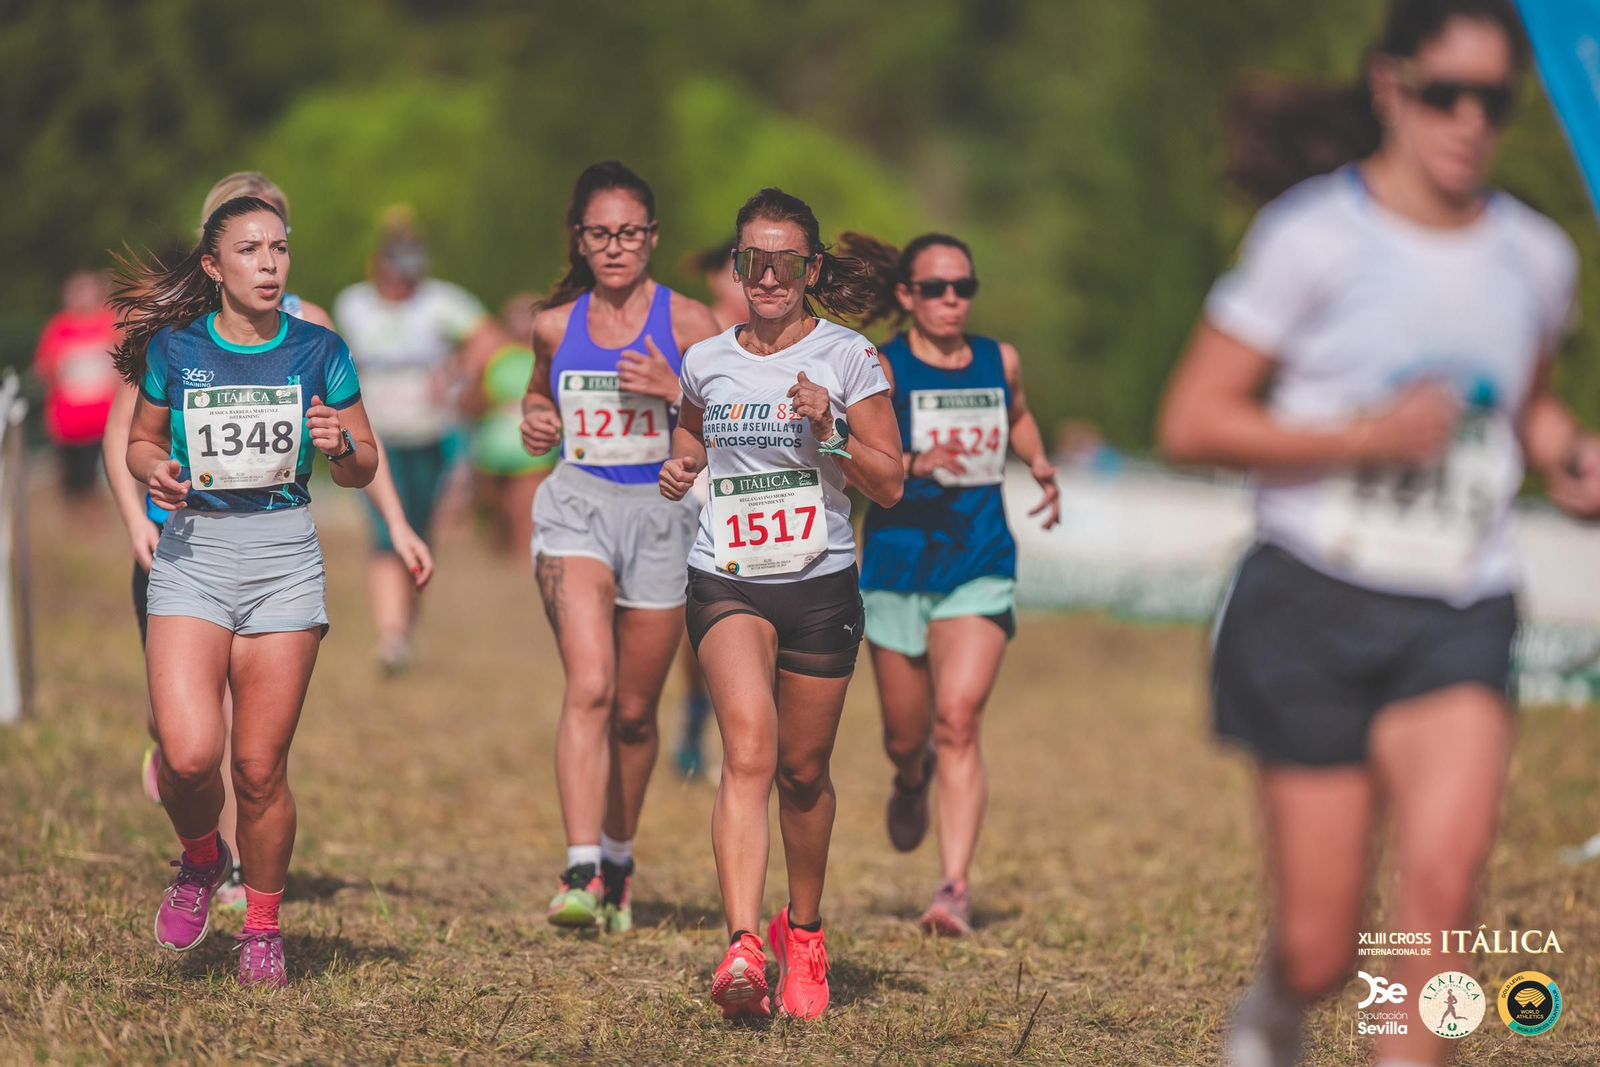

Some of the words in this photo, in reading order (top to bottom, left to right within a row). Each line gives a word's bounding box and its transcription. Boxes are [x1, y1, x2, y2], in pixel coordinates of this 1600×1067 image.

[181, 368, 207, 381] 365
[182, 380, 212, 389] TRAINING
[217, 389, 270, 404] ITÁLICA
[703, 403, 771, 421] CIRCUITO
[776, 403, 787, 420] 8
[574, 408, 661, 437] 1271
[198, 420, 294, 457] 1348
[704, 434, 803, 449] divinaseguros
[739, 474, 791, 491] ITÁLICA
[773, 491, 795, 499] MORENO
[748, 498, 785, 508] INDEPENDIENTE
[726, 505, 817, 548] 1517
